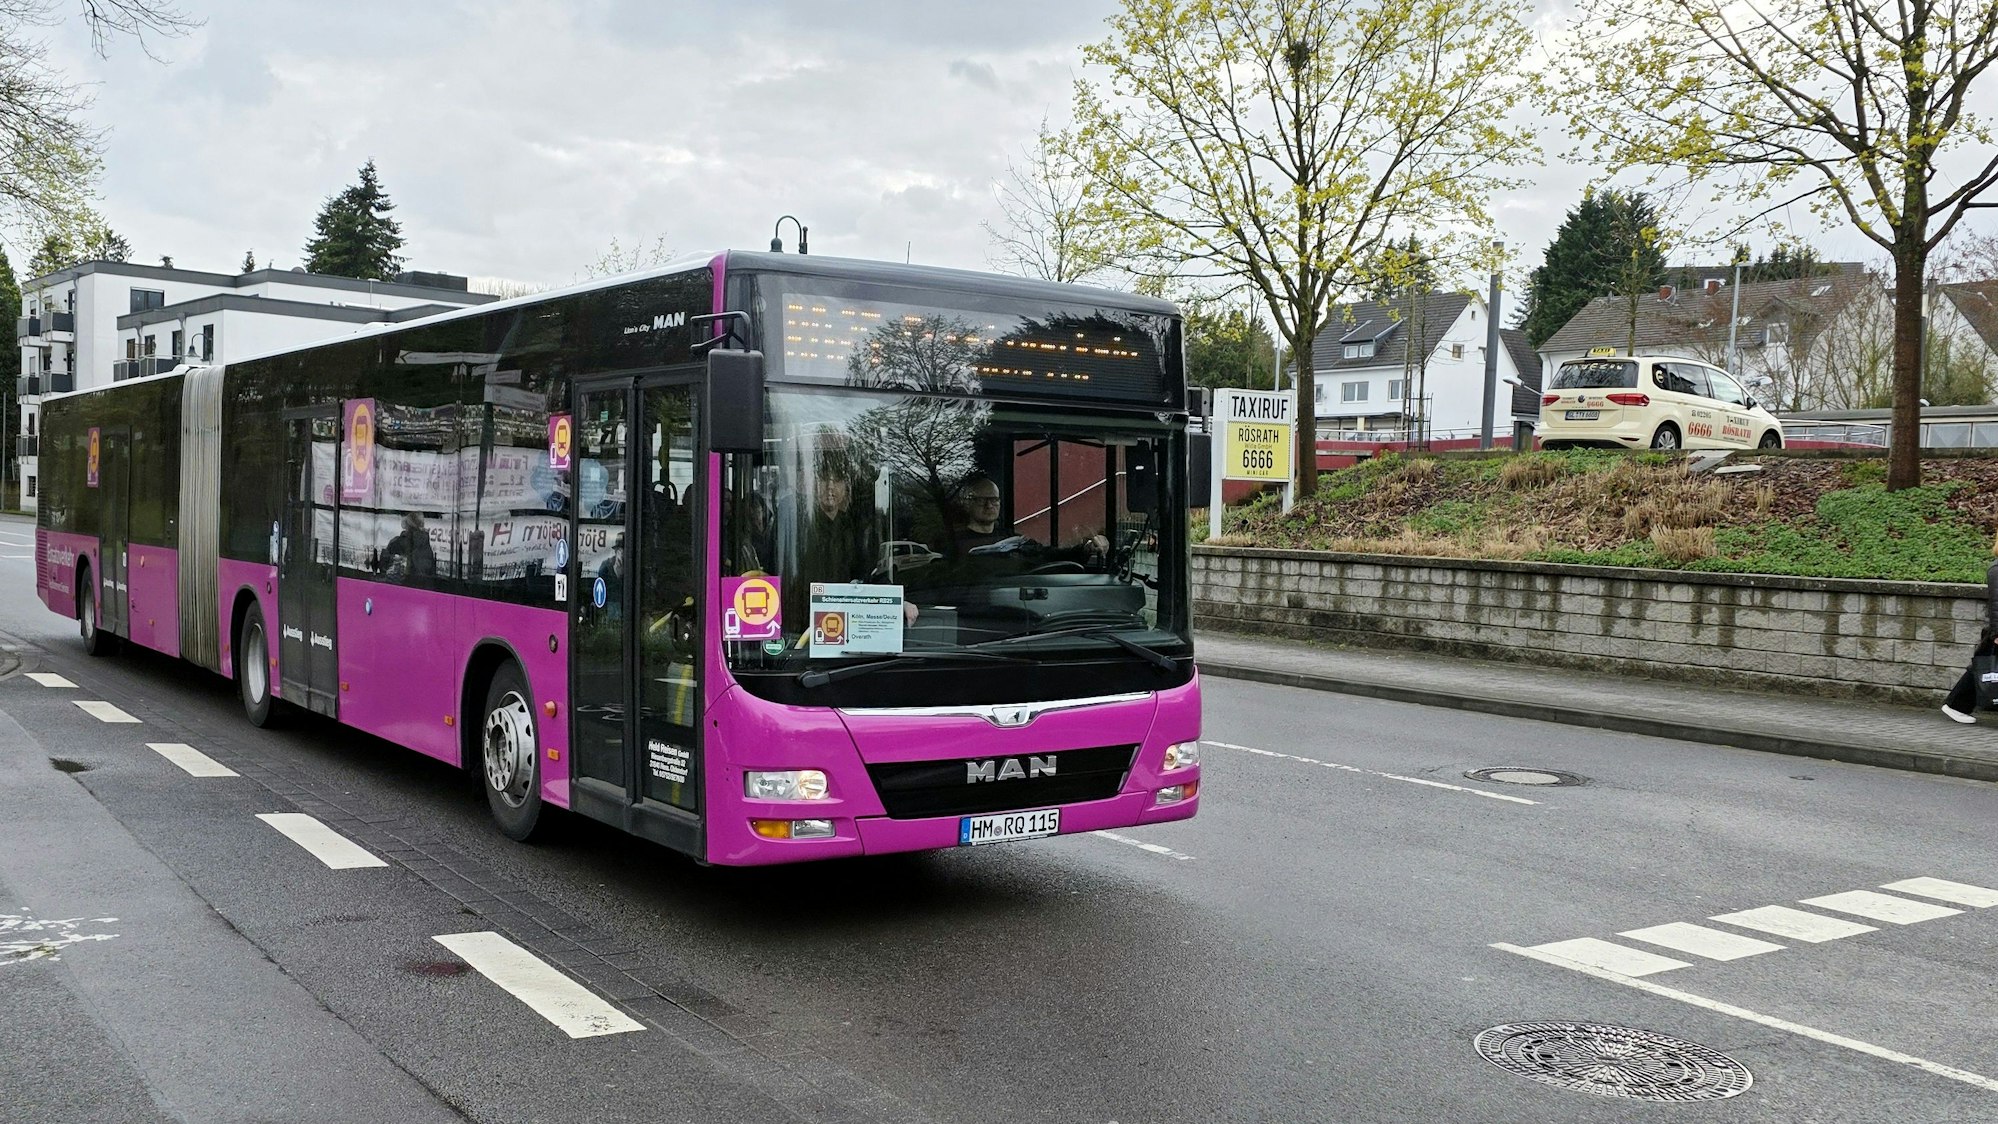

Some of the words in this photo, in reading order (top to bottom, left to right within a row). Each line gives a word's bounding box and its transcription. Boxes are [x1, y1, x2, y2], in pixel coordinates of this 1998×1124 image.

[639, 324, 650, 332] City
[653, 311, 685, 330] MAN
[1231, 395, 1289, 419] TAXIRUF
[1238, 424, 1279, 443] RÖSRATH
[1687, 421, 1713, 438] 6666
[1722, 423, 1752, 439] RÖSRATH
[1242, 449, 1273, 469] 6666
[813, 586, 824, 594] DB
[965, 755, 1057, 784] MAN
[971, 819, 994, 839] HM
[1004, 816, 1025, 836] RQ
[1028, 812, 1057, 833] 115
